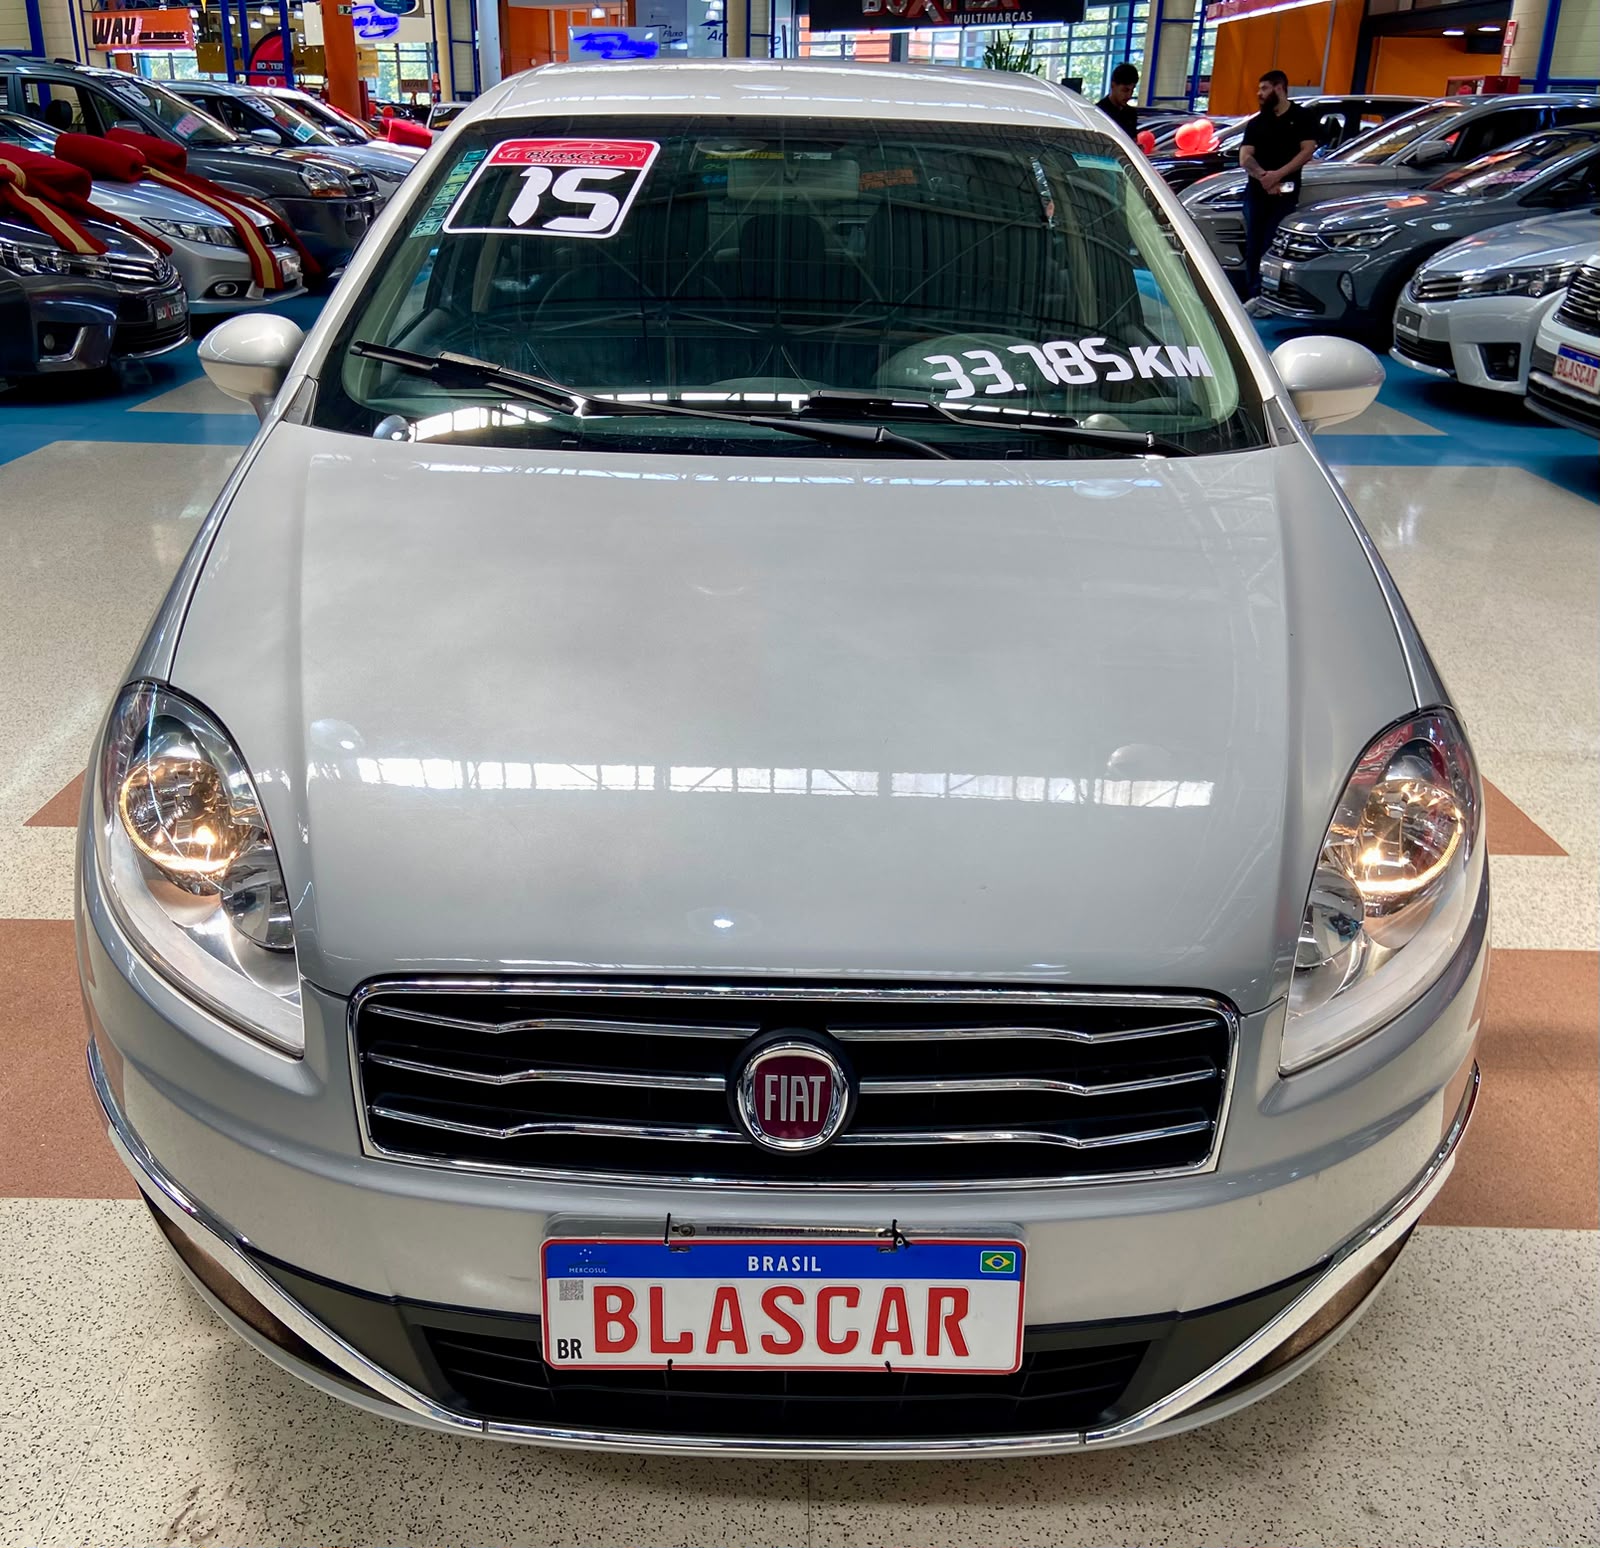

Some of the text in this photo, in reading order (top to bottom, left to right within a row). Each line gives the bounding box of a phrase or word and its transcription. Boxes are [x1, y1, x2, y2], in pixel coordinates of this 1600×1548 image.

[954, 11, 1033, 25] MULTIMARCAS
[92, 17, 137, 45] WAY
[256, 61, 284, 71] BOXTER
[525, 150, 624, 161] BlasCar
[507, 166, 626, 232] 15
[157, 302, 183, 320] BOXTER
[1556, 357, 1598, 388] BLASCAR
[764, 1074, 826, 1122] FIAT
[747, 1255, 822, 1272] BRASIL
[593, 1285, 970, 1357] BLASCAR
[556, 1338, 583, 1359] BR
